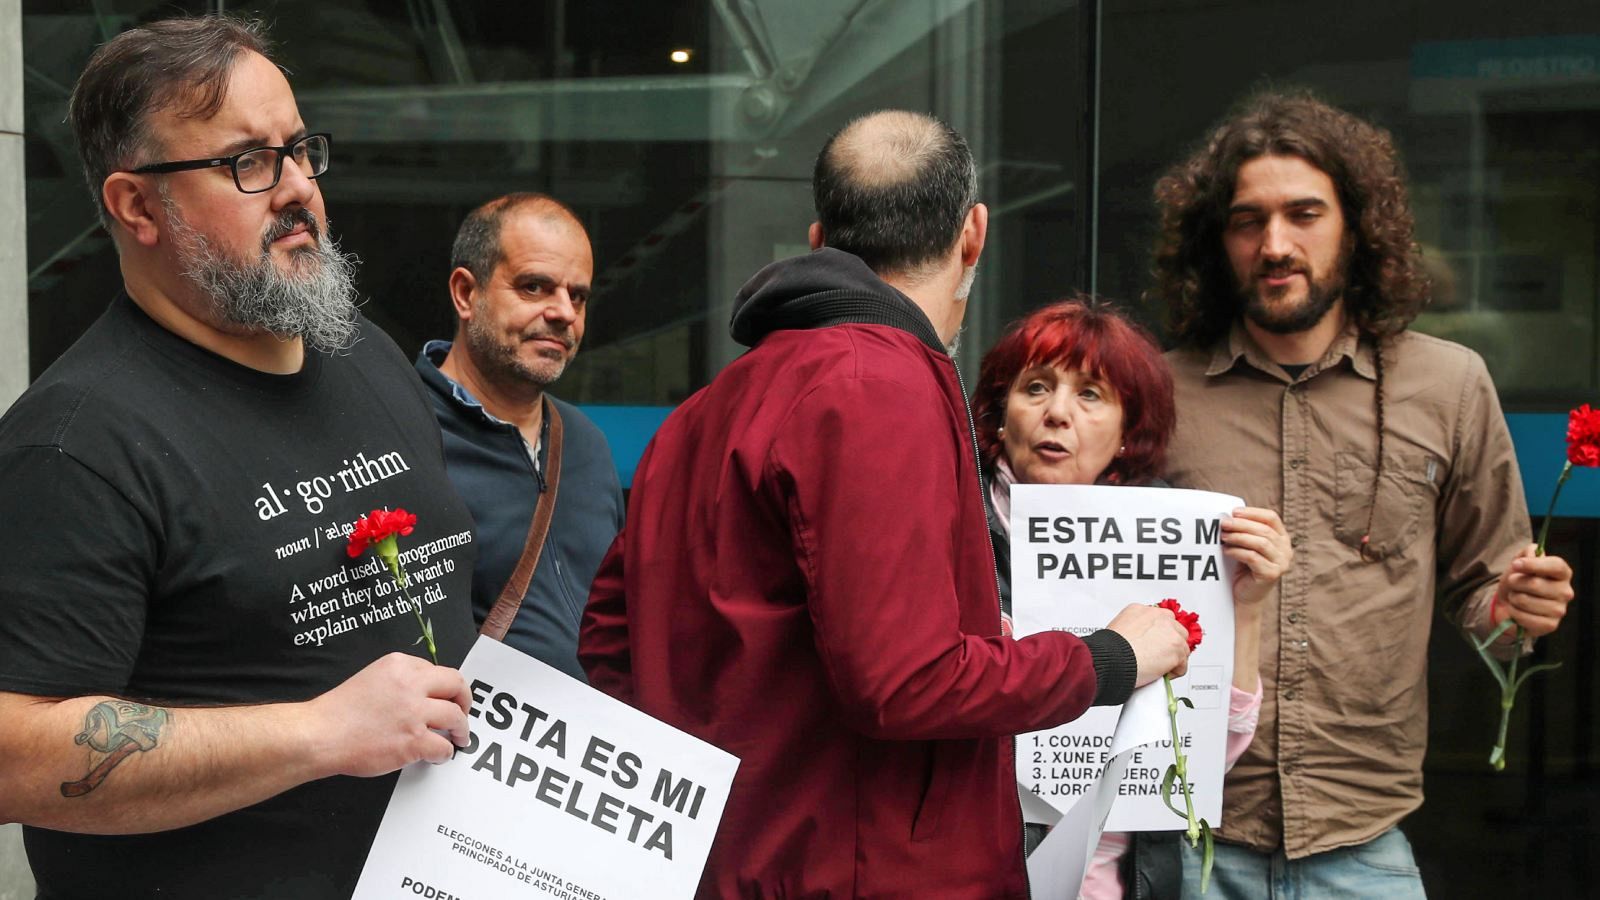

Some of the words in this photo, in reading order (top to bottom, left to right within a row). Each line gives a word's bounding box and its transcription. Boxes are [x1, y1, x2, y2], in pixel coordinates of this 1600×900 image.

[1028, 517, 1123, 543] ESTA
[1136, 518, 1182, 544] ES
[1195, 518, 1224, 545] M
[275, 537, 312, 560] noun
[289, 584, 305, 604] A
[308, 566, 349, 595] word
[350, 556, 380, 580] used
[398, 530, 472, 566] programmers
[1037, 553, 1220, 581] PAPELETA
[290, 601, 340, 624] when
[342, 590, 372, 612] they
[374, 578, 392, 598] do
[412, 562, 444, 584] want
[443, 558, 455, 574] to
[293, 616, 358, 646] explain
[360, 604, 395, 627] what
[423, 583, 447, 605] did.
[468, 678, 567, 759] ESTA
[581, 735, 643, 790] ES
[650, 768, 707, 820] MI
[1032, 735, 1044, 748] 1.
[1033, 751, 1047, 764] 2.
[1052, 752, 1095, 764] XUNE
[1032, 767, 1046, 780] 3.
[1031, 783, 1046, 796] 4.
[1050, 783, 1092, 796] JOR
[437, 824, 503, 860] ELECCIONES
[505, 855, 512, 864] A
[515, 858, 528, 871] LA
[530, 866, 563, 887] JUNTA
[566, 881, 606, 900] GENER
[451, 842, 515, 876] PRINCIPADO
[517, 871, 531, 884] DE
[401, 876, 460, 900] PODE
